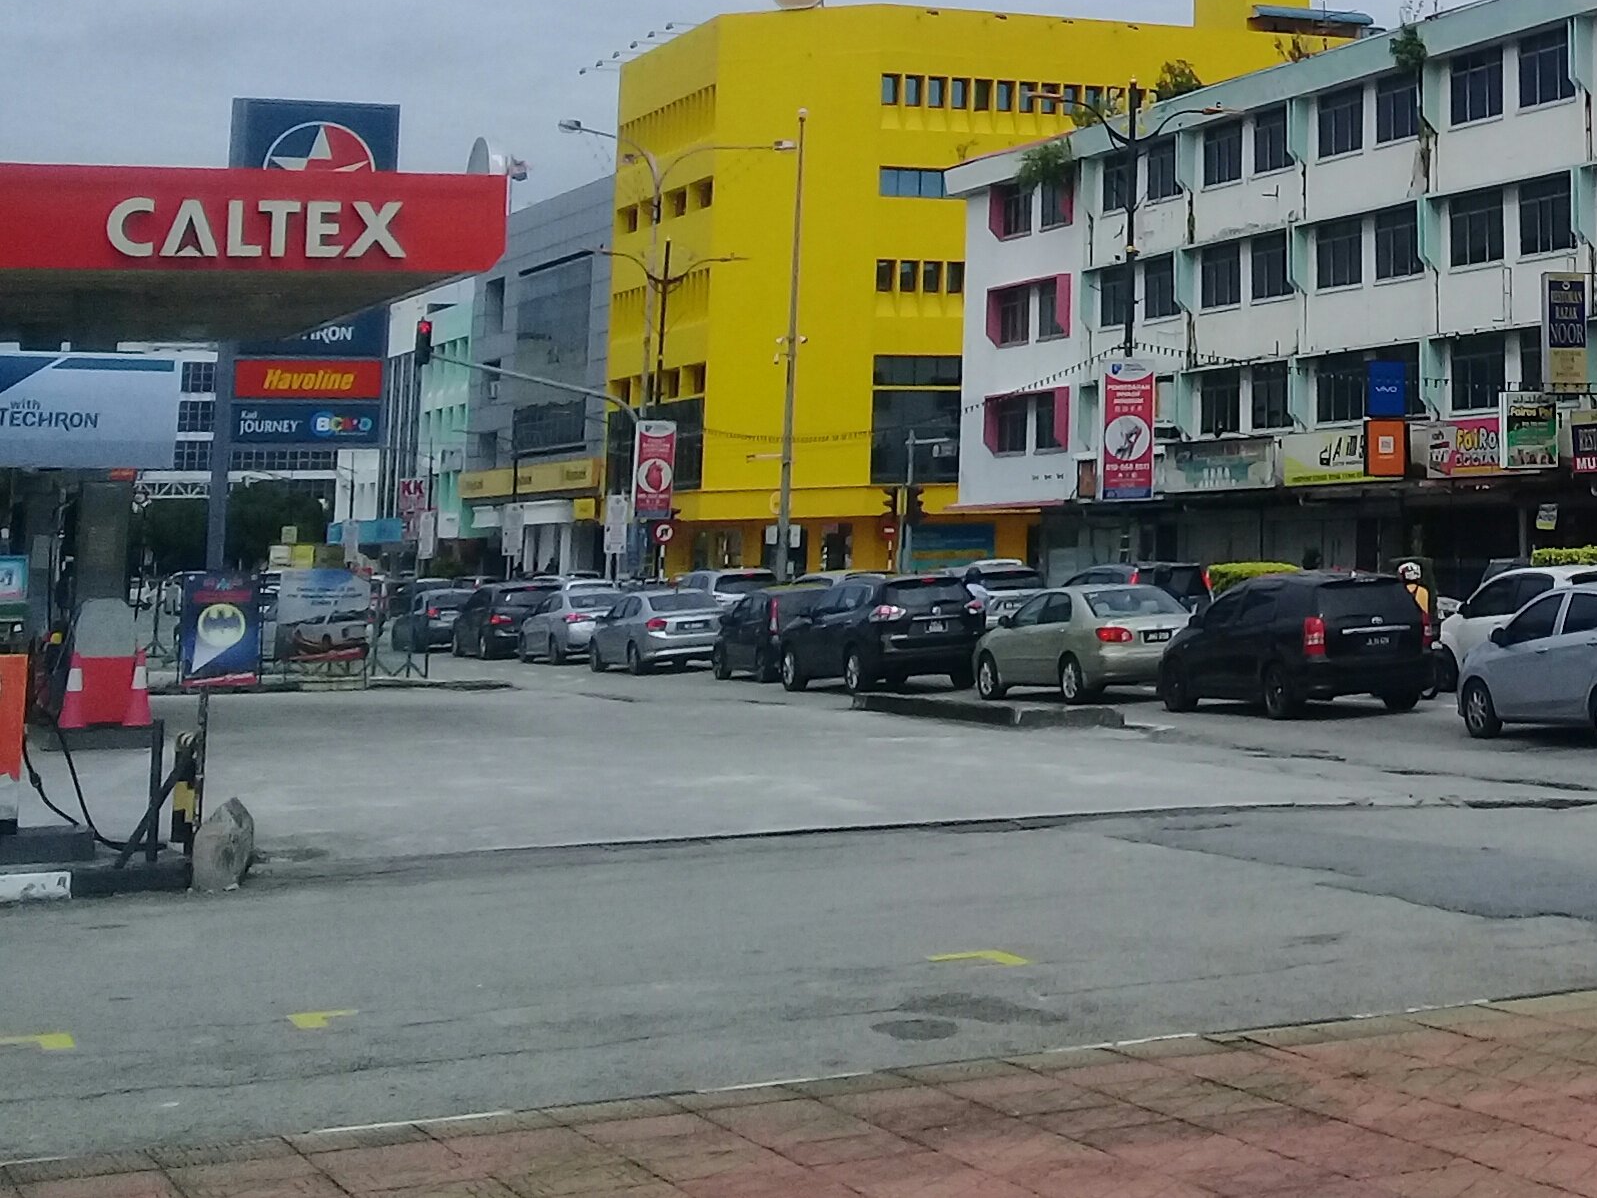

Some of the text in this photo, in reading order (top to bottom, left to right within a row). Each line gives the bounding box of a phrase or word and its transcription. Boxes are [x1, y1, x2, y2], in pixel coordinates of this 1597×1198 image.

[107, 197, 406, 259] CALTEX
[1550, 323, 1584, 343] NOOR
[263, 369, 354, 390] Havoline
[10, 397, 41, 410] with
[0, 408, 99, 431] TECHRON
[240, 420, 298, 435] JOURNEY
